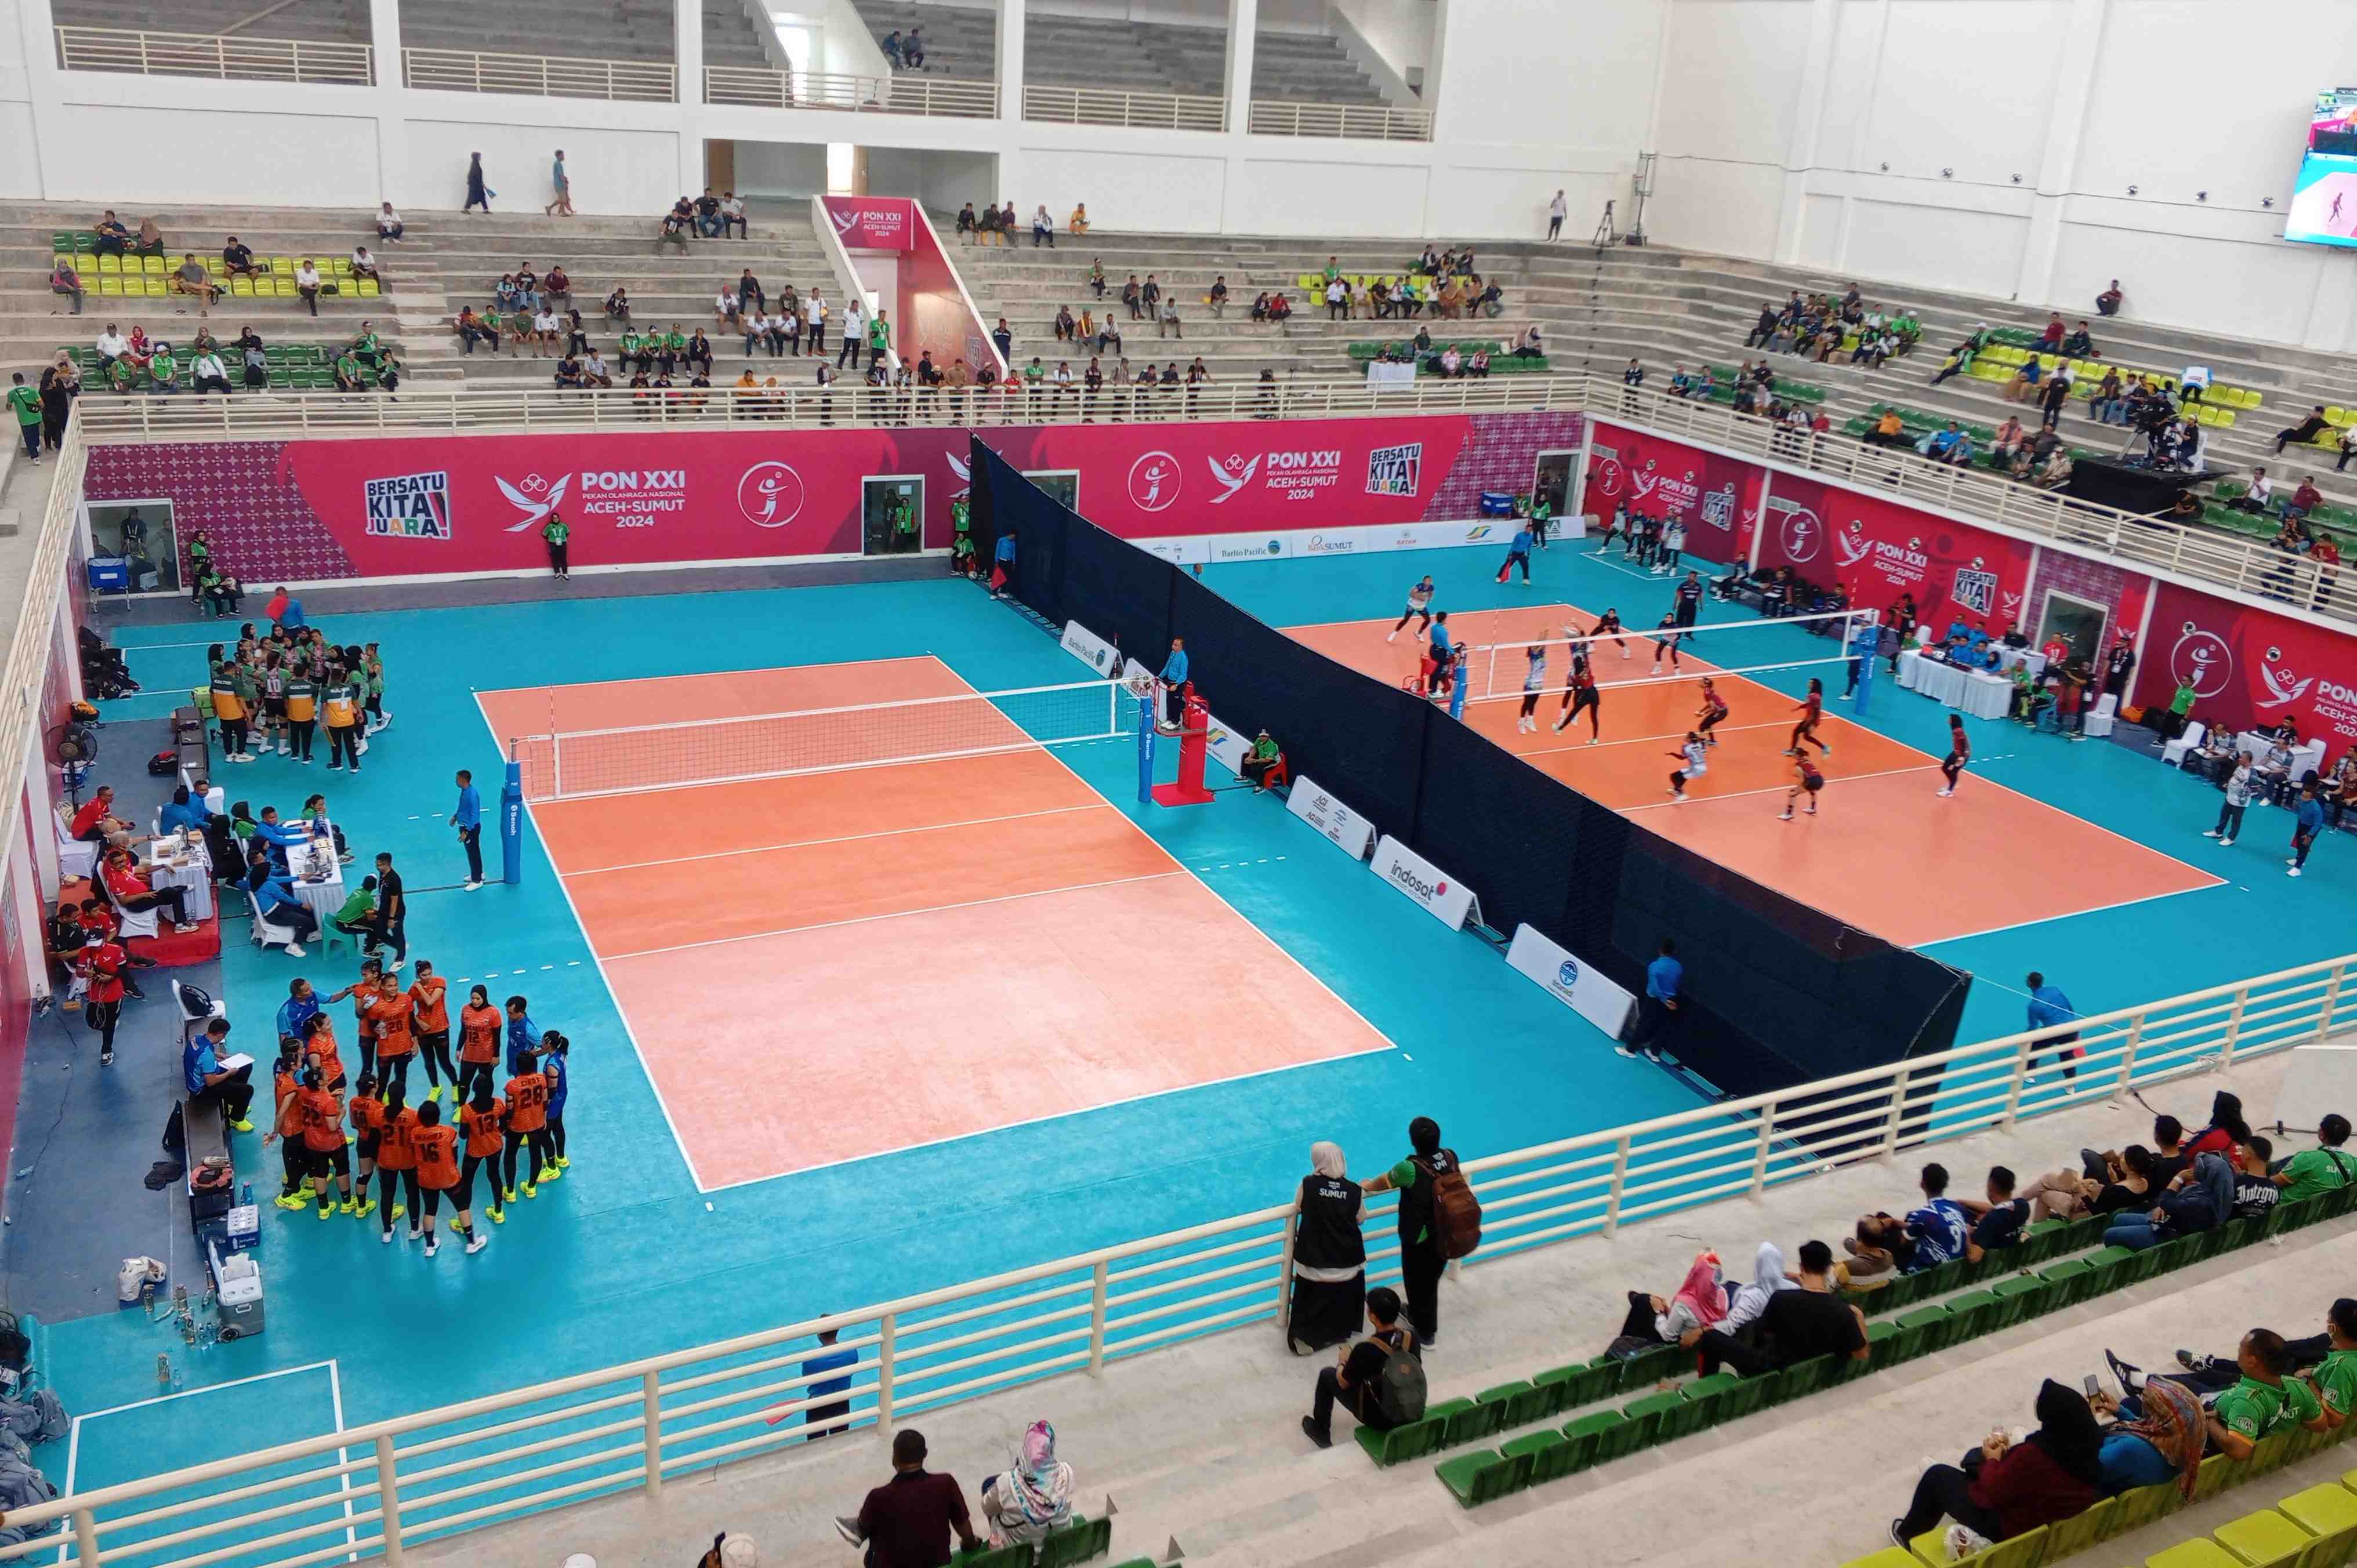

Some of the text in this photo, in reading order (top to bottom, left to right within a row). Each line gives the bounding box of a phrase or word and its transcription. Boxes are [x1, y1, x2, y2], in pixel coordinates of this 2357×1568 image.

[863, 212, 901, 222] PON XXI
[1267, 450, 1341, 470] PON XXI
[1371, 445, 1420, 463] BERSATU
[1369, 460, 1407, 480] KITA
[368, 473, 444, 496] BERSATU
[582, 470, 686, 491] PON XXI
[1265, 475, 1339, 488] ACEH-SUMUT
[1287, 488, 1315, 500] 2024
[369, 493, 433, 518] KITA
[583, 499, 686, 514] ACEH-SUMUT
[616, 515, 655, 528] 2024
[1221, 547, 1267, 557] Barito Pacific
[1876, 541, 1905, 561] PON
[1904, 550, 1928, 568] XXI
[1873, 560, 1926, 582] ACEH-SUMUT
[1956, 580, 1983, 601] KITA
[1390, 859, 1434, 901] indosat
[388, 1020, 404, 1033] 20
[467, 1030, 479, 1044] 12
[521, 1076, 540, 1086] CINDY
[520, 1084, 543, 1109] 28
[382, 1124, 405, 1148] 21
[1319, 1188, 1348, 1200] SUMUT
[1949, 1224, 1961, 1254] 9
